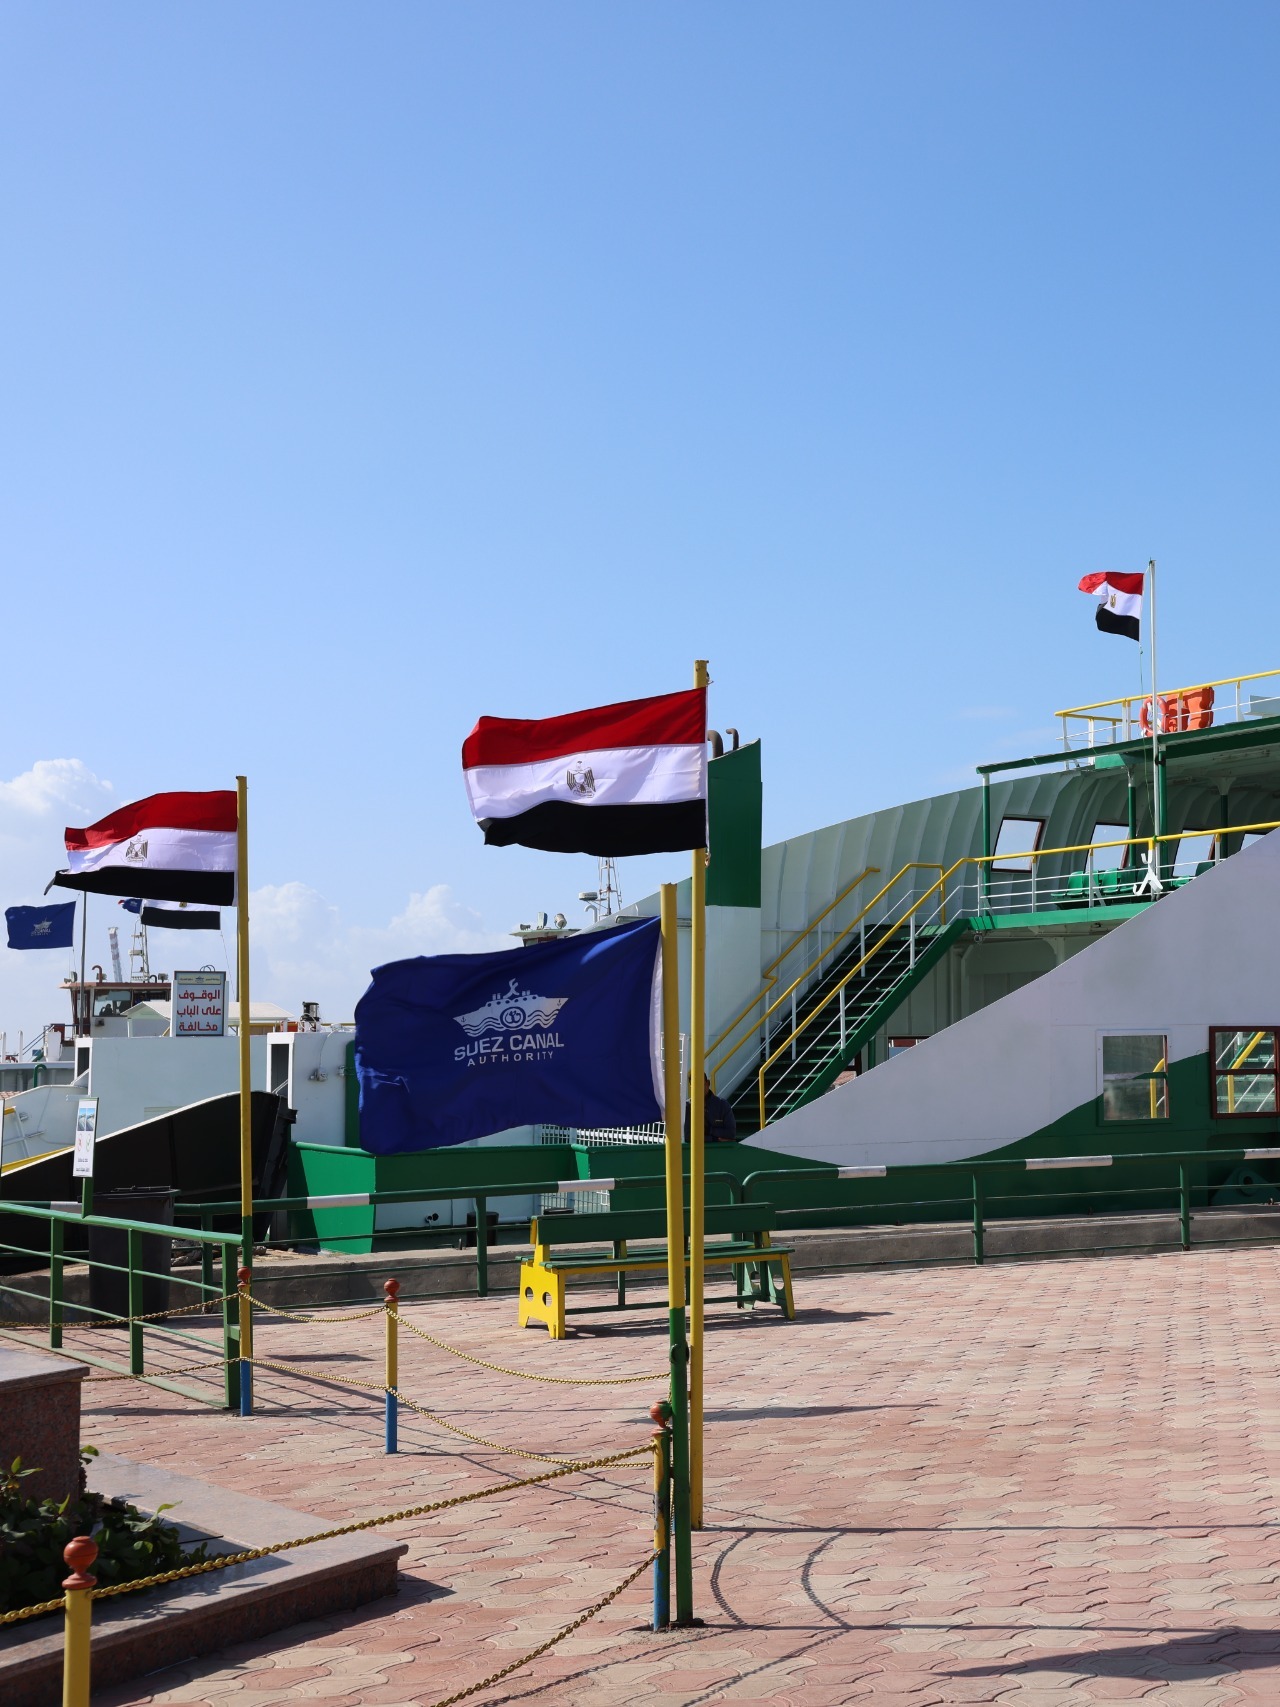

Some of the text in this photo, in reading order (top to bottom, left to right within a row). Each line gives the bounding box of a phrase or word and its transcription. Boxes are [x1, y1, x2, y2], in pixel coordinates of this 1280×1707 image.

[178, 989, 220, 1002] الوقوف
[176, 1005, 222, 1018] على الباب
[178, 1021, 218, 1032] مخالفة
[454, 1032, 565, 1061] SUEZ CANAL
[467, 1051, 554, 1067] AUTHORITY
